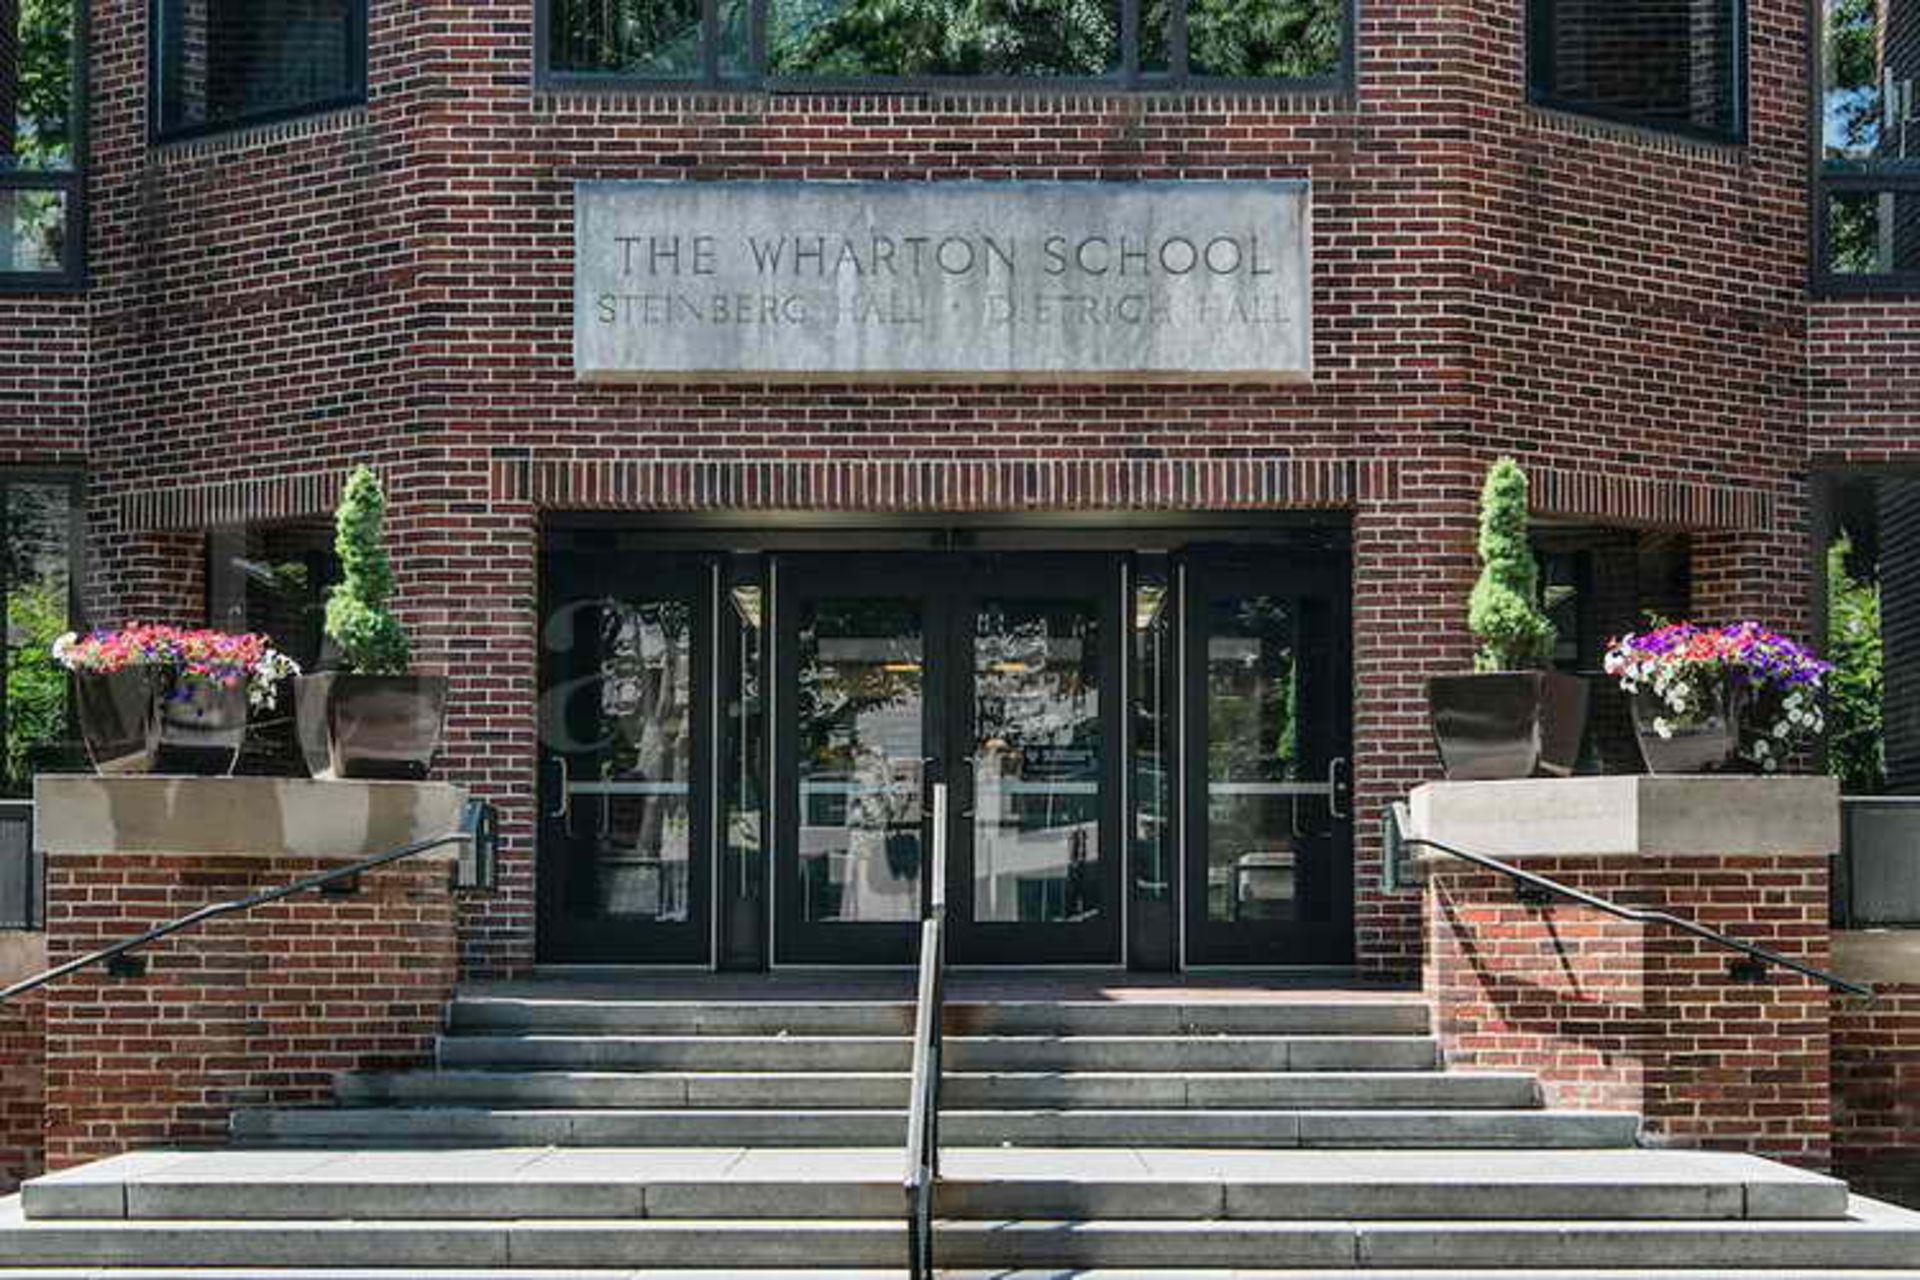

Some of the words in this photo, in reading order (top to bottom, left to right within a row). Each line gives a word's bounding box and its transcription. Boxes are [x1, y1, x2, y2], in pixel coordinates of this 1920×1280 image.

[614, 236, 716, 276] THE
[749, 235, 1015, 276] WHARTON
[1043, 235, 1272, 276] SCHOOL
[597, 294, 806, 325] STEINBERG
[986, 293, 1173, 326] DIETRICH
